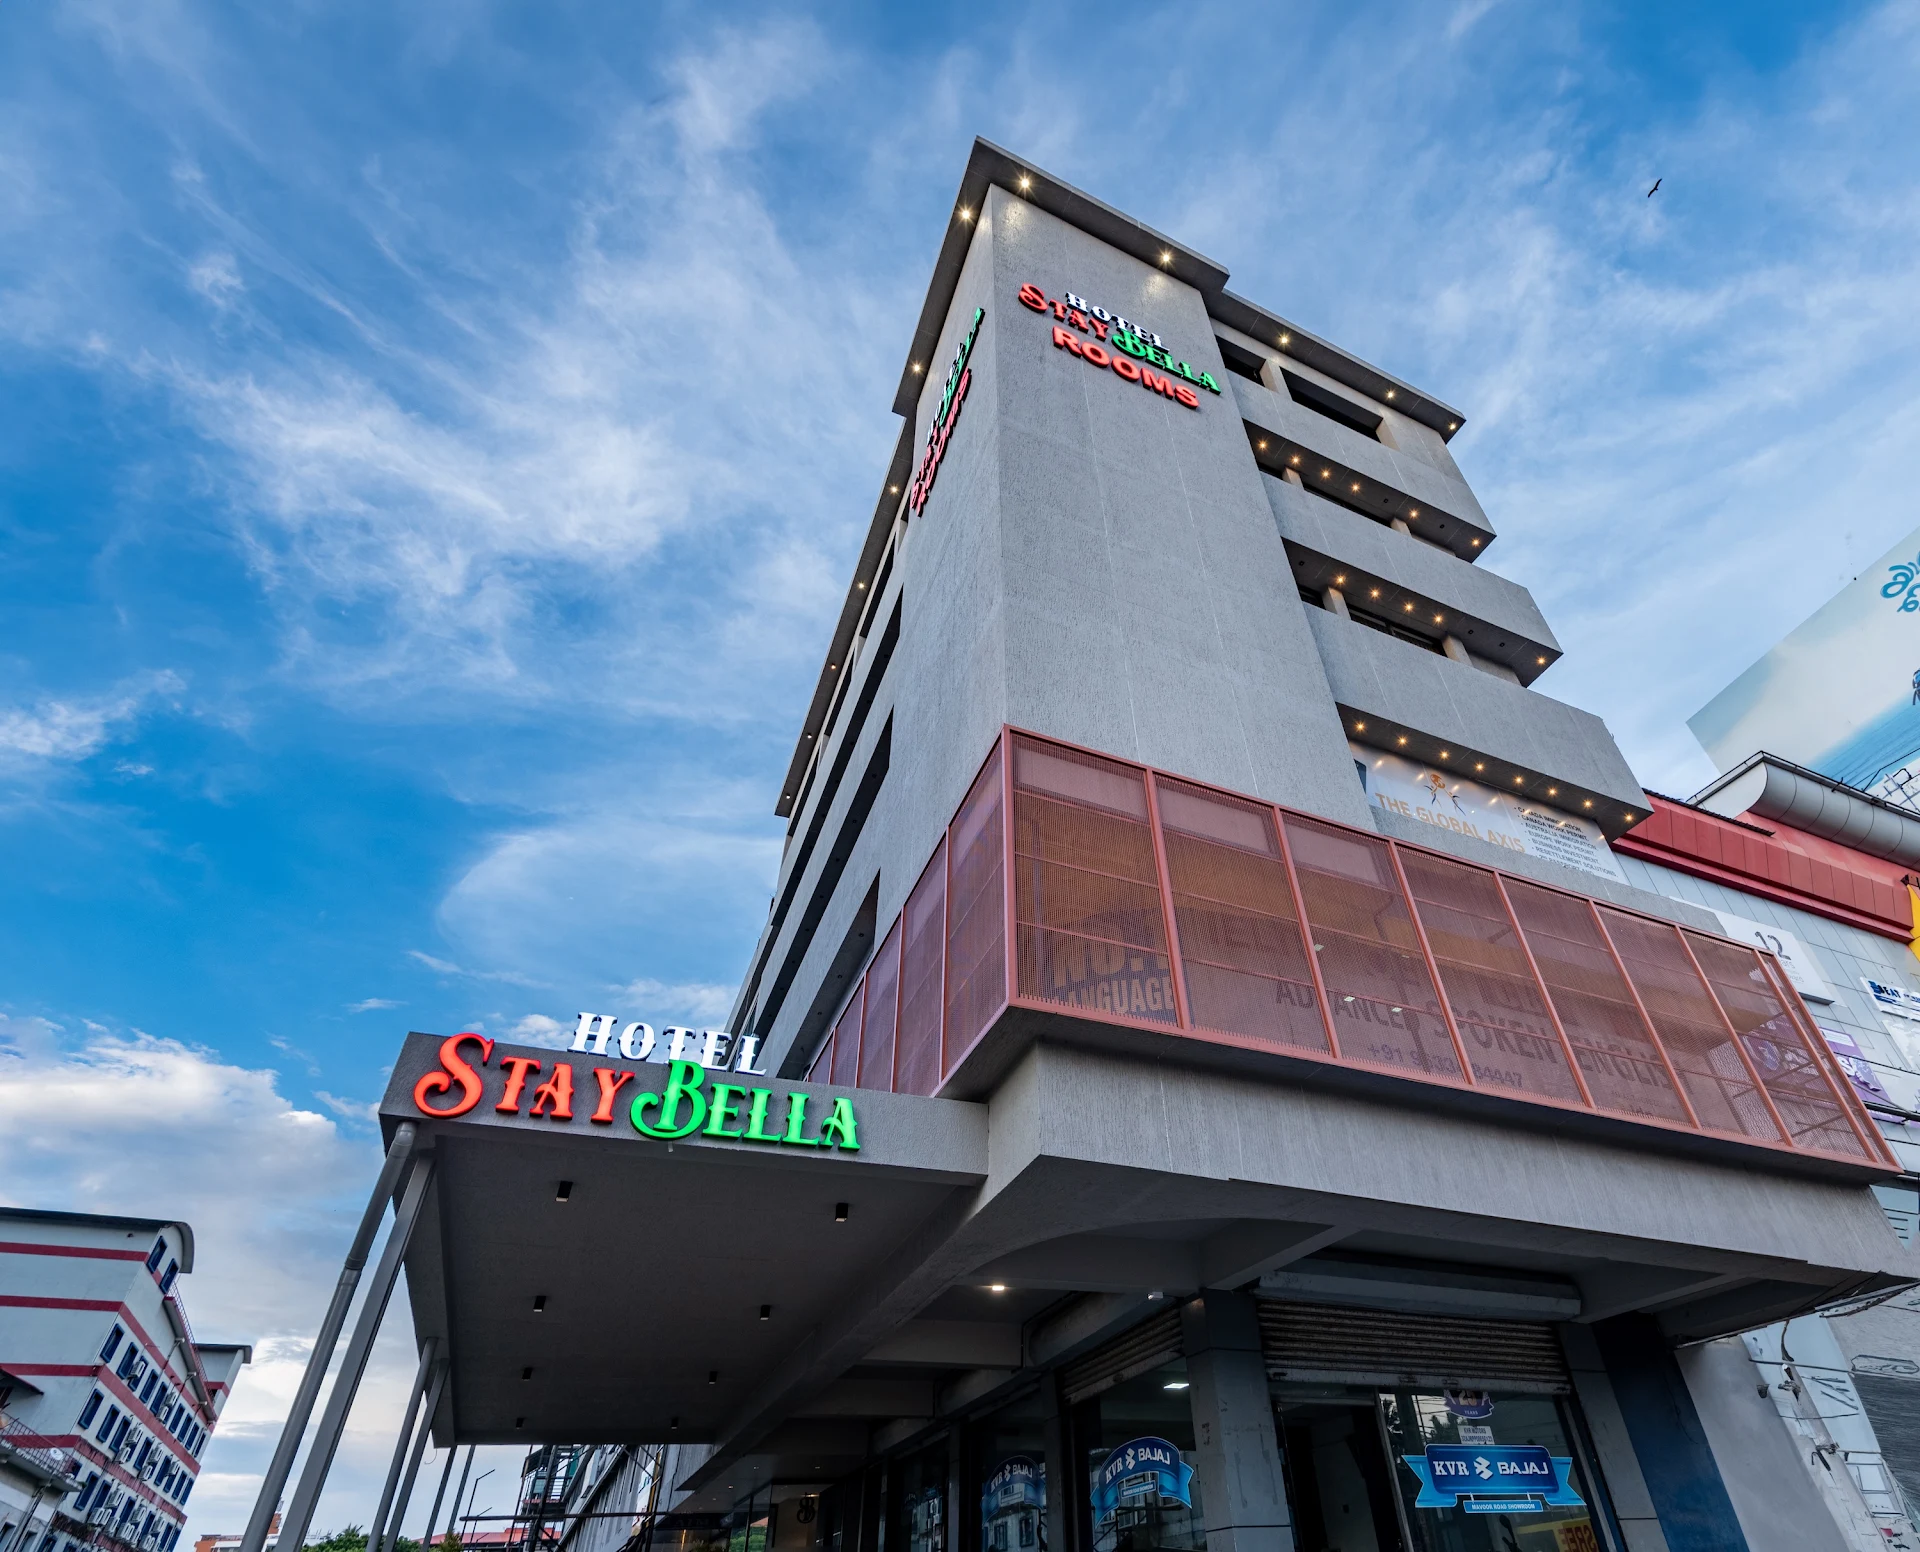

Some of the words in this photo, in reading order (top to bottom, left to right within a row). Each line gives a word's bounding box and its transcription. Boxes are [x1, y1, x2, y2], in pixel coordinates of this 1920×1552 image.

[1018, 282, 1109, 342] STAY
[1111, 329, 1221, 395] BELLA
[1066, 291, 1170, 353] HOTEL
[1052, 326, 1200, 409] ROOMS
[1375, 792, 1412, 818] THE
[1415, 806, 1484, 840] GLOBAL
[1487, 829, 1526, 853] AXIS
[1518, 806, 1542, 820] CAADA
[1521, 814, 1547, 827] CANADA
[1547, 823, 1565, 833] WORK
[1525, 822, 1558, 838] AUSTRALIA
[1528, 830, 1554, 844] EUROPE
[1555, 838, 1573, 850] WORK
[1532, 838, 1563, 853] BUSINESS
[1535, 846, 1582, 866] RESETTLEMENT
[1755, 931, 1792, 960] 12
[1054, 976, 1175, 1016] ANGUAGE
[566, 1011, 766, 1076] HOTEL
[413, 1032, 635, 1124] STAY
[629, 1058, 861, 1152] BELLA
[1105, 1457, 1123, 1484] KVR
[1138, 1447, 1171, 1465] BAJAJ
[1433, 1460, 1469, 1476] KVR
[1496, 1461, 1549, 1475] BAJAJ
